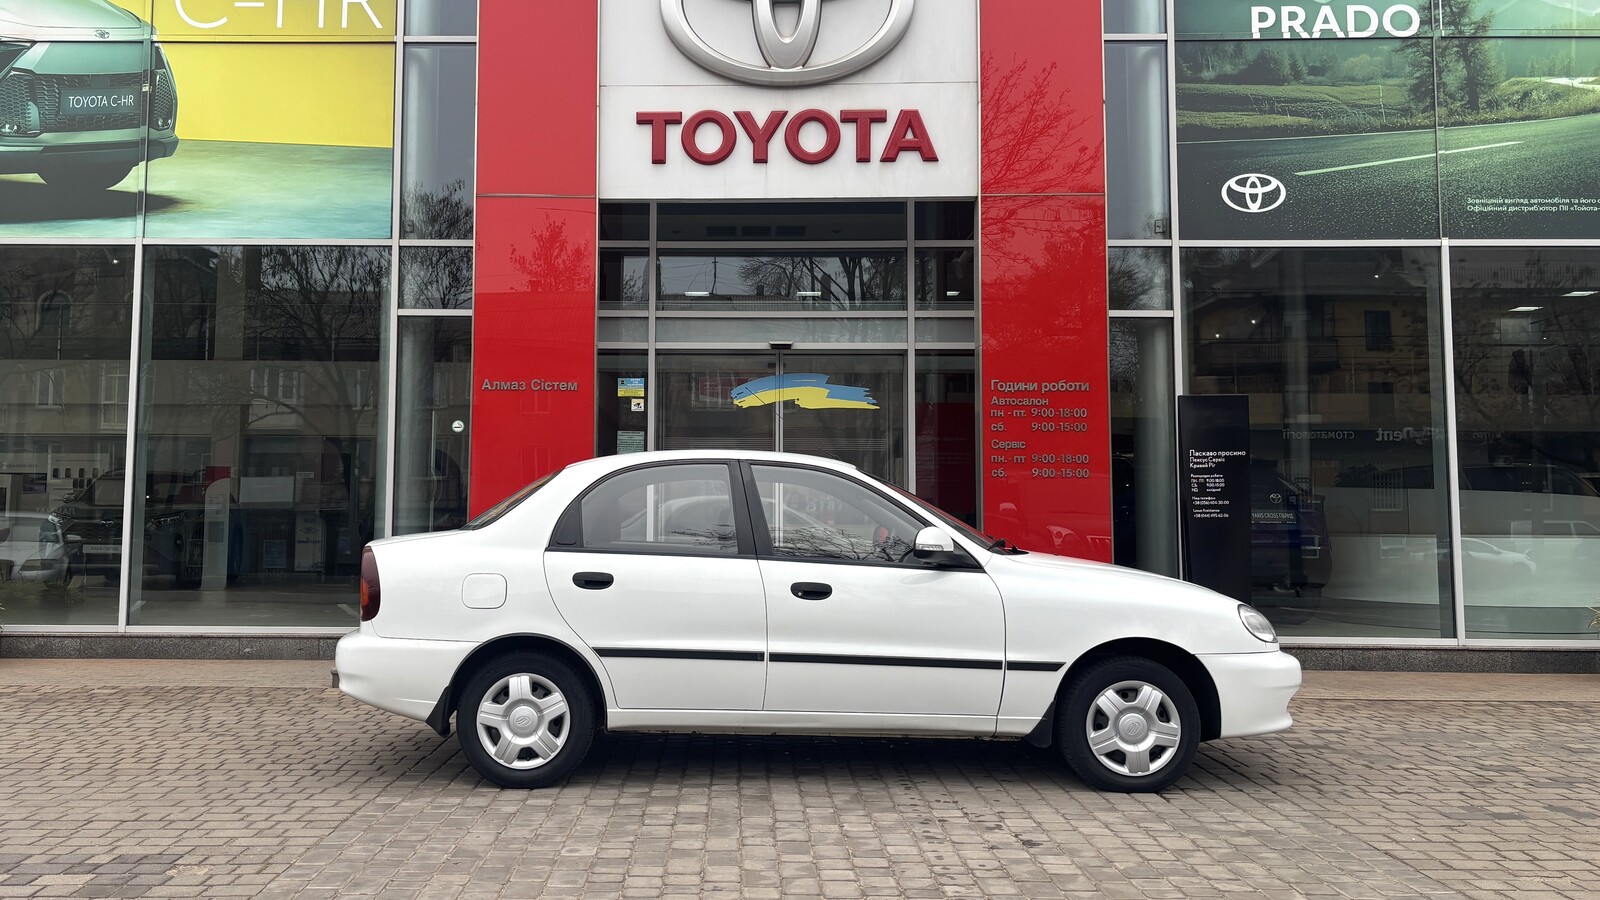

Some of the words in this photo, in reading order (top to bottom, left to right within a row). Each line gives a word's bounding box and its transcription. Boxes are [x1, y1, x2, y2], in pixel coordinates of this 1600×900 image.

[1251, 4, 1421, 38] PRADO
[68, 95, 108, 108] TOYOTA
[110, 94, 134, 107] C-HR
[636, 108, 939, 165] TOYOTA
[1580, 197, 1597, 205] його
[481, 378, 527, 391] Алмаз
[530, 378, 578, 391] Сістем
[990, 379, 1038, 392] Години
[1041, 380, 1090, 394] роботи
[990, 396, 1049, 406] Автосалон
[1031, 408, 1088, 418] 9:00-18:00
[991, 422, 1007, 431] сб.
[1031, 422, 1088, 432] 9:00-15:00
[991, 439, 1026, 451] Сервіс
[1031, 454, 1090, 463] 9:00-18:00
[1189, 449, 1217, 457] Ласкаво
[991, 467, 1008, 477] сб.
[1032, 468, 1090, 478] 9:00-15:00
